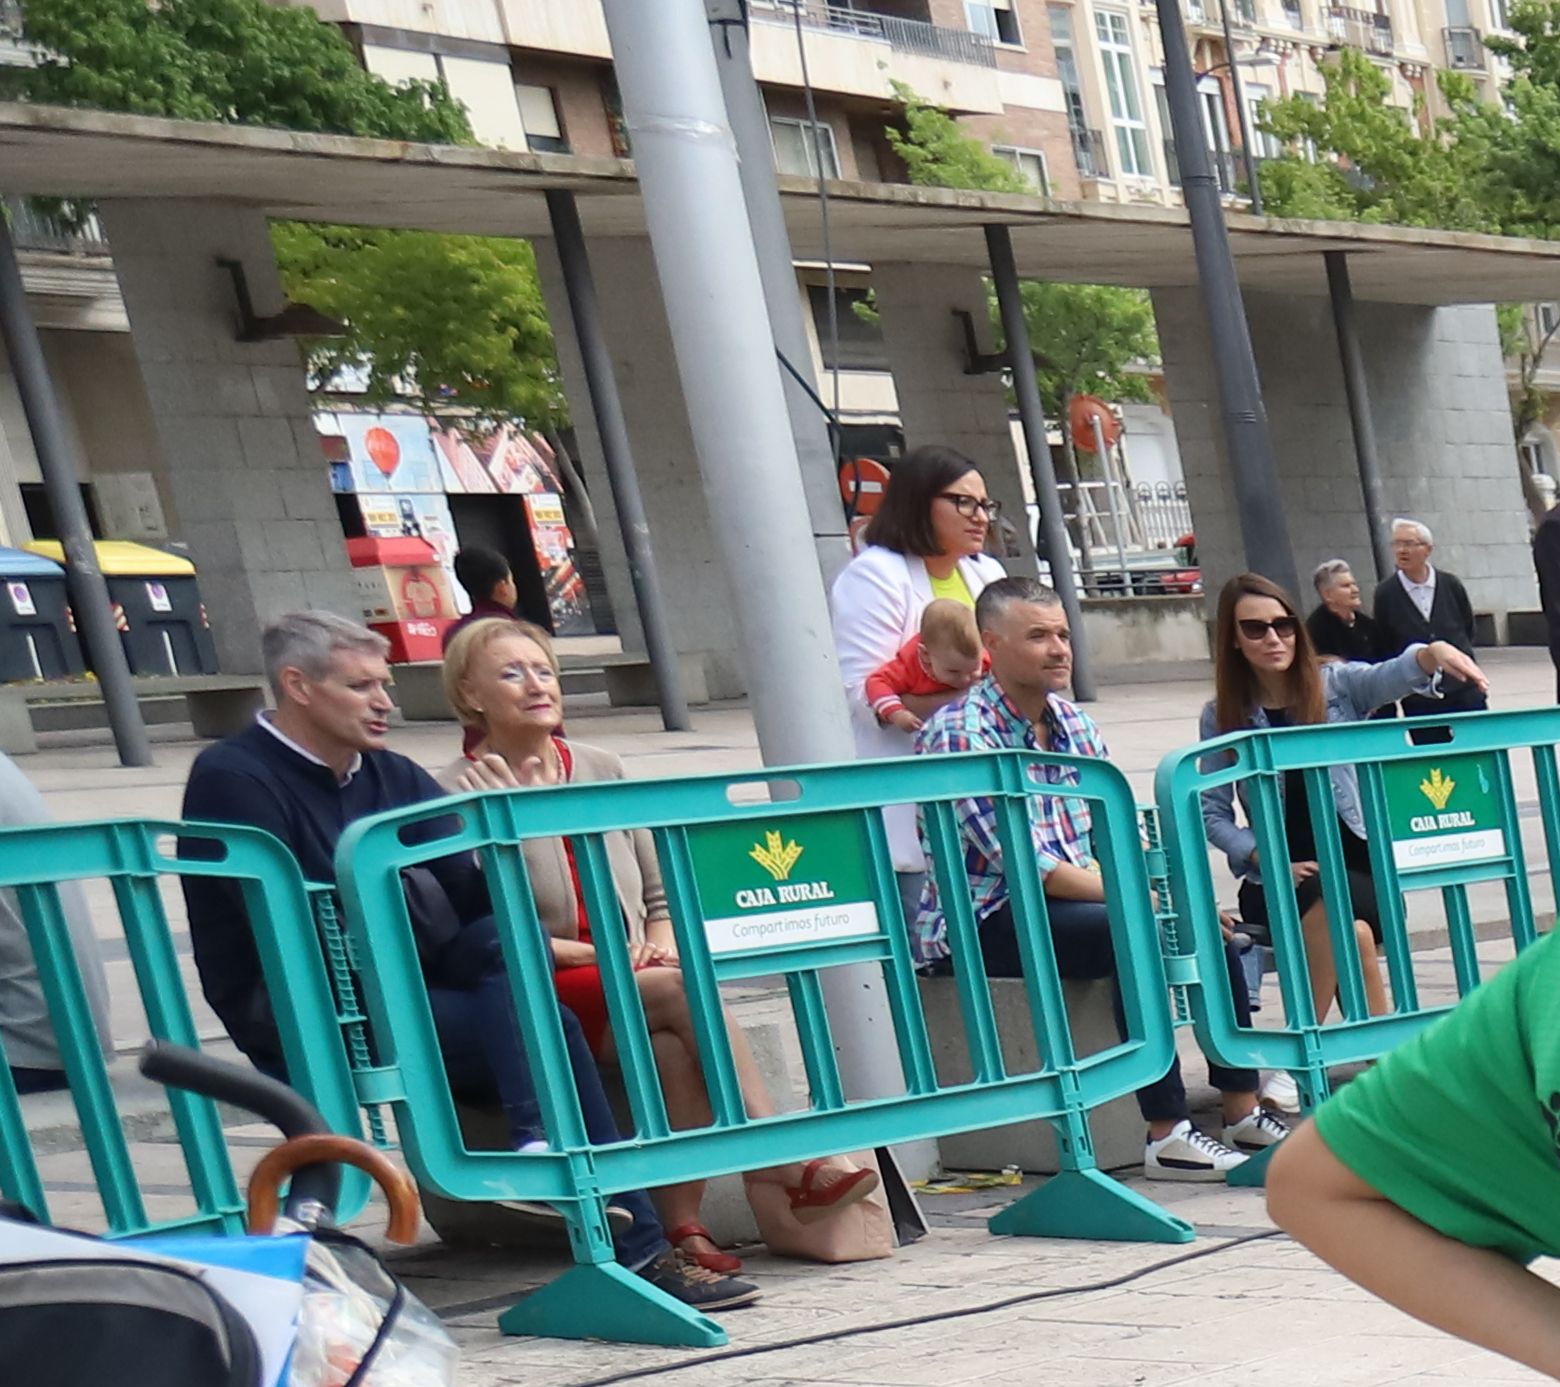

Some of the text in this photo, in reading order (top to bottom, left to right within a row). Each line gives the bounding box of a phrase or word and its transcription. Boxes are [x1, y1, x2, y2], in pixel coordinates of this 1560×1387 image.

[1410, 811, 1475, 831] CAJA RURAL
[736, 881, 834, 908] CAJA RURAL
[732, 912, 850, 938] Compartimos futuro
